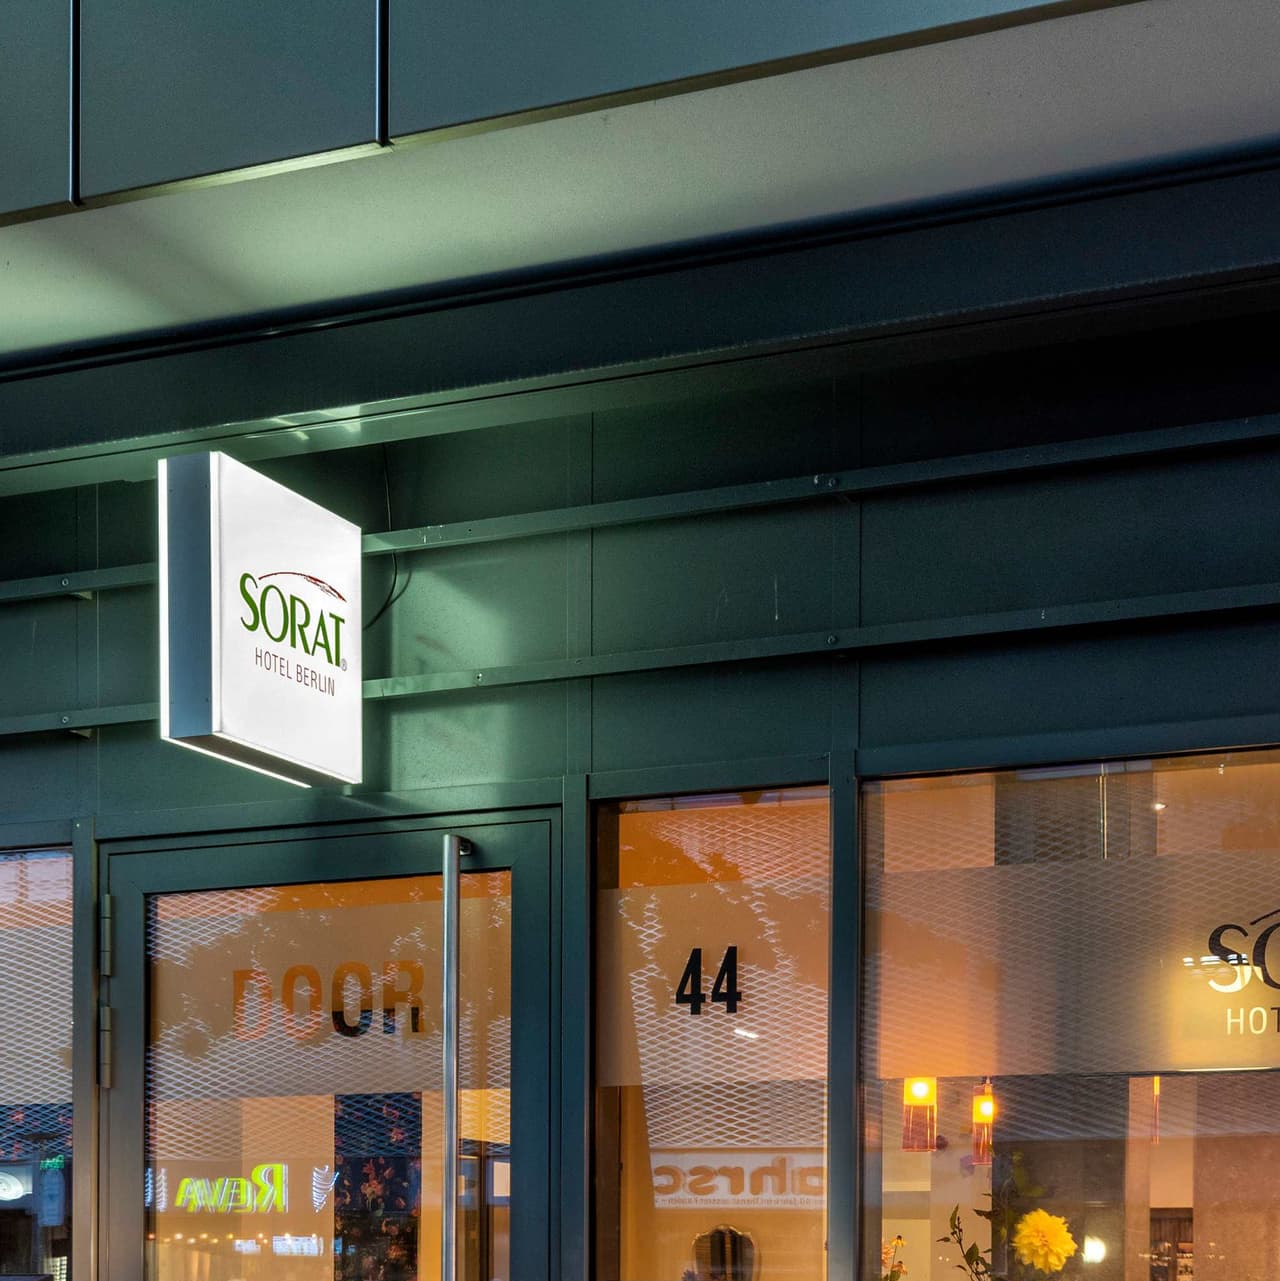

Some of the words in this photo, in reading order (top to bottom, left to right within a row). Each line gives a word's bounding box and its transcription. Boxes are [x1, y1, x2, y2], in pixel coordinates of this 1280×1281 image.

[240, 573, 345, 668] SORAT
[255, 647, 292, 680] HOTEL
[296, 663, 335, 697] BERLIN
[232, 960, 424, 1042] DOOR
[675, 945, 742, 1015] 44
